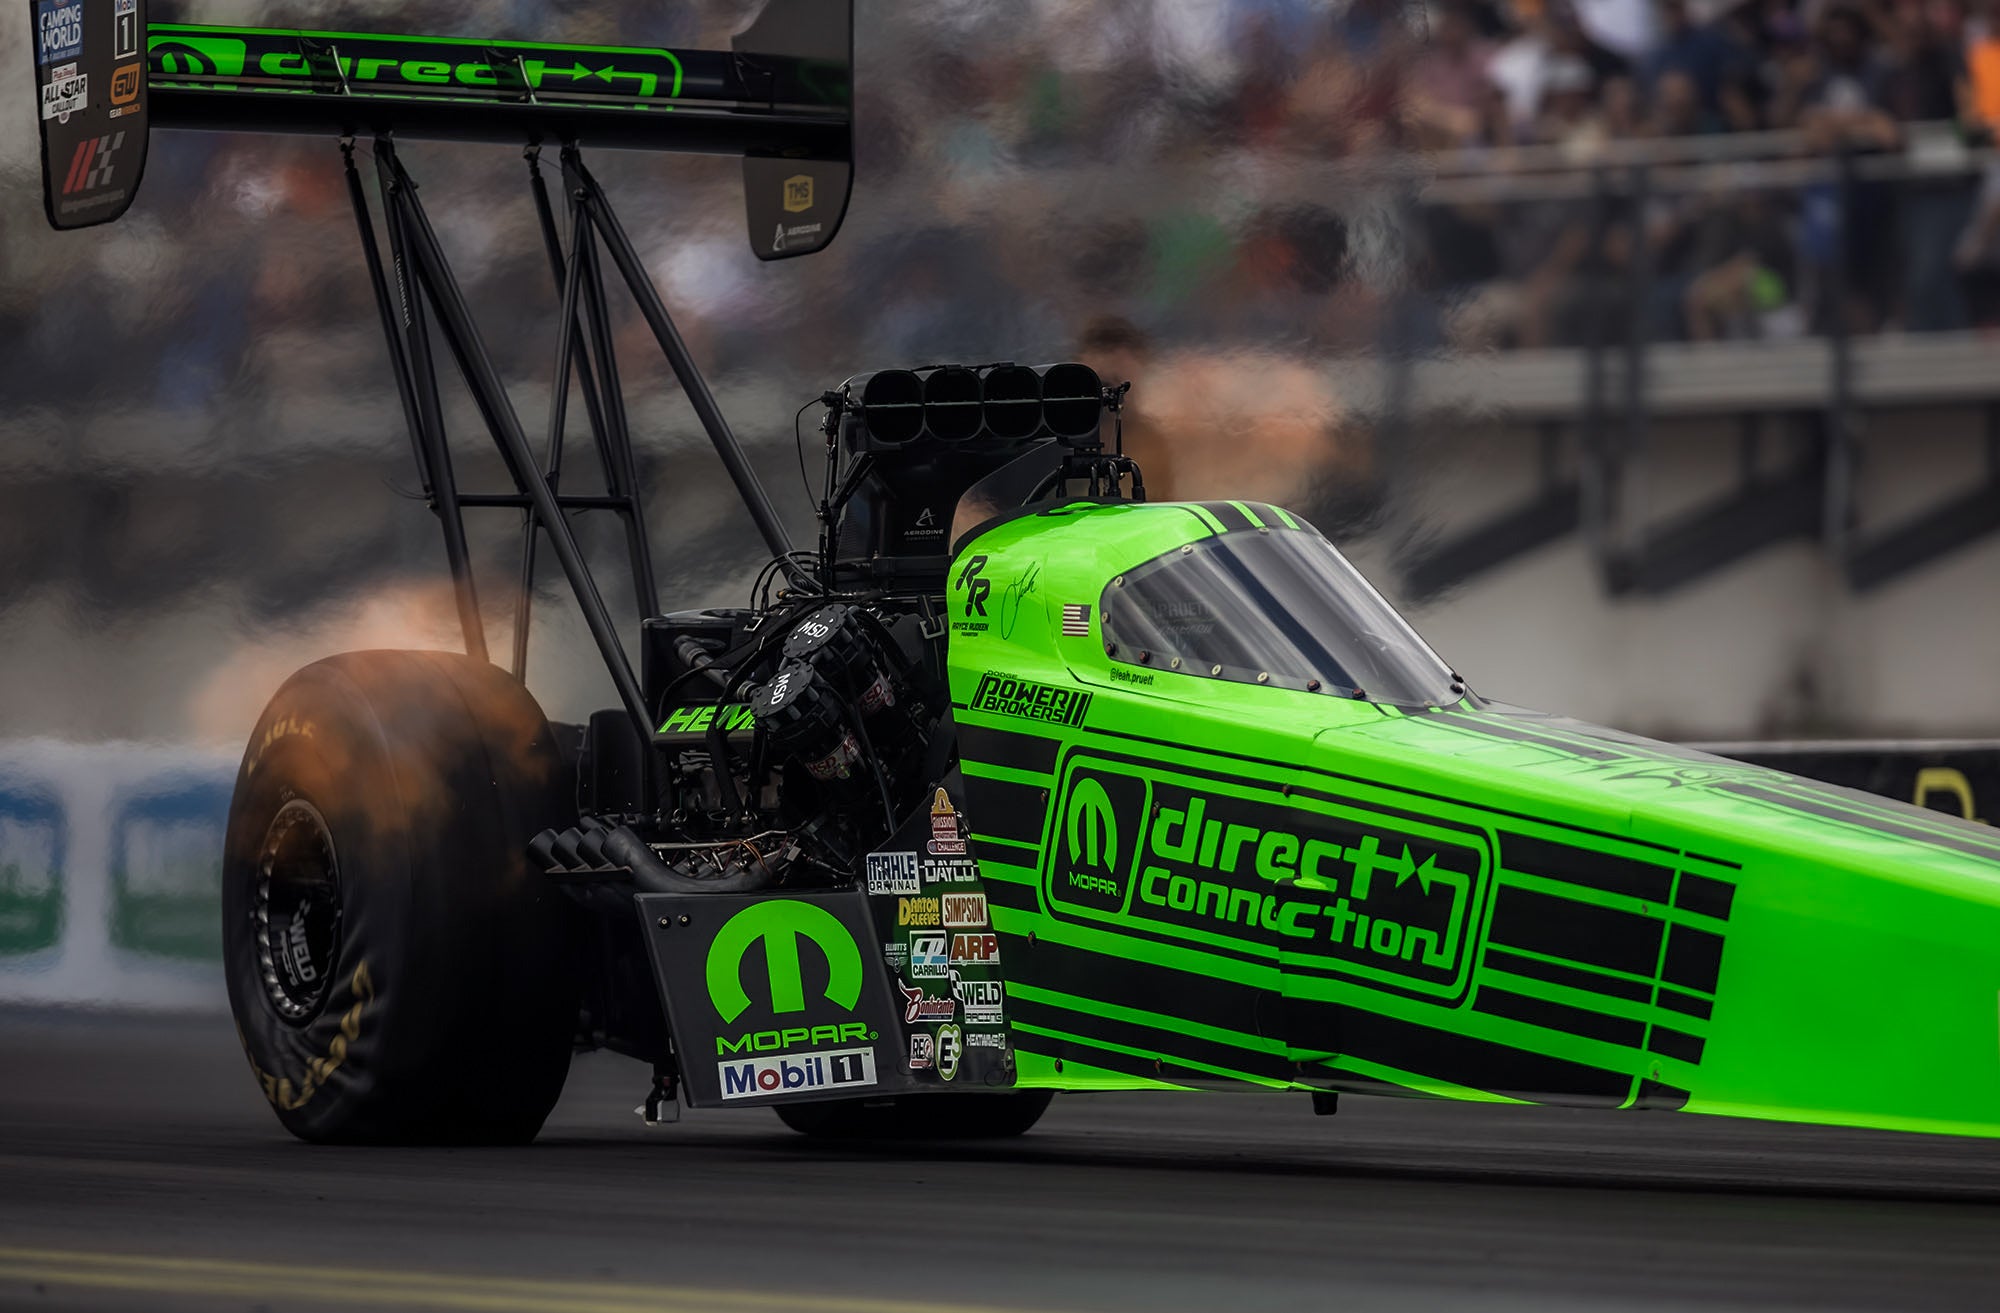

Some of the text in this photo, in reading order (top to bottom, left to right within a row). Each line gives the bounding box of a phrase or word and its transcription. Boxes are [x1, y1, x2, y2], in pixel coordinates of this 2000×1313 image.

[41, 4, 81, 31] CAMPING
[41, 23, 81, 52] WORLD
[121, 17, 129, 50] 1
[903, 529, 944, 537] AERODINE
[798, 621, 829, 639] MSD
[987, 670, 1018, 680] DODGE
[1110, 667, 1154, 686] @leah.pruett
[771, 672, 791, 706] MSD
[974, 676, 1070, 709] POWER
[983, 697, 1066, 722] BROKERS
[937, 842, 965, 852] CHALLENGE
[1150, 797, 1381, 900] direct
[868, 855, 916, 881] MAHLE
[924, 860, 976, 882] DAYCO
[910, 913, 940, 926] SLEEVES
[945, 897, 983, 923] SIMPSON
[289, 923, 318, 983] WELD
[950, 935, 998, 961] ARP
[912, 963, 948, 977] CARRILLO
[961, 983, 1002, 1006] WELD
[723, 1055, 852, 1095] Mobil 1
